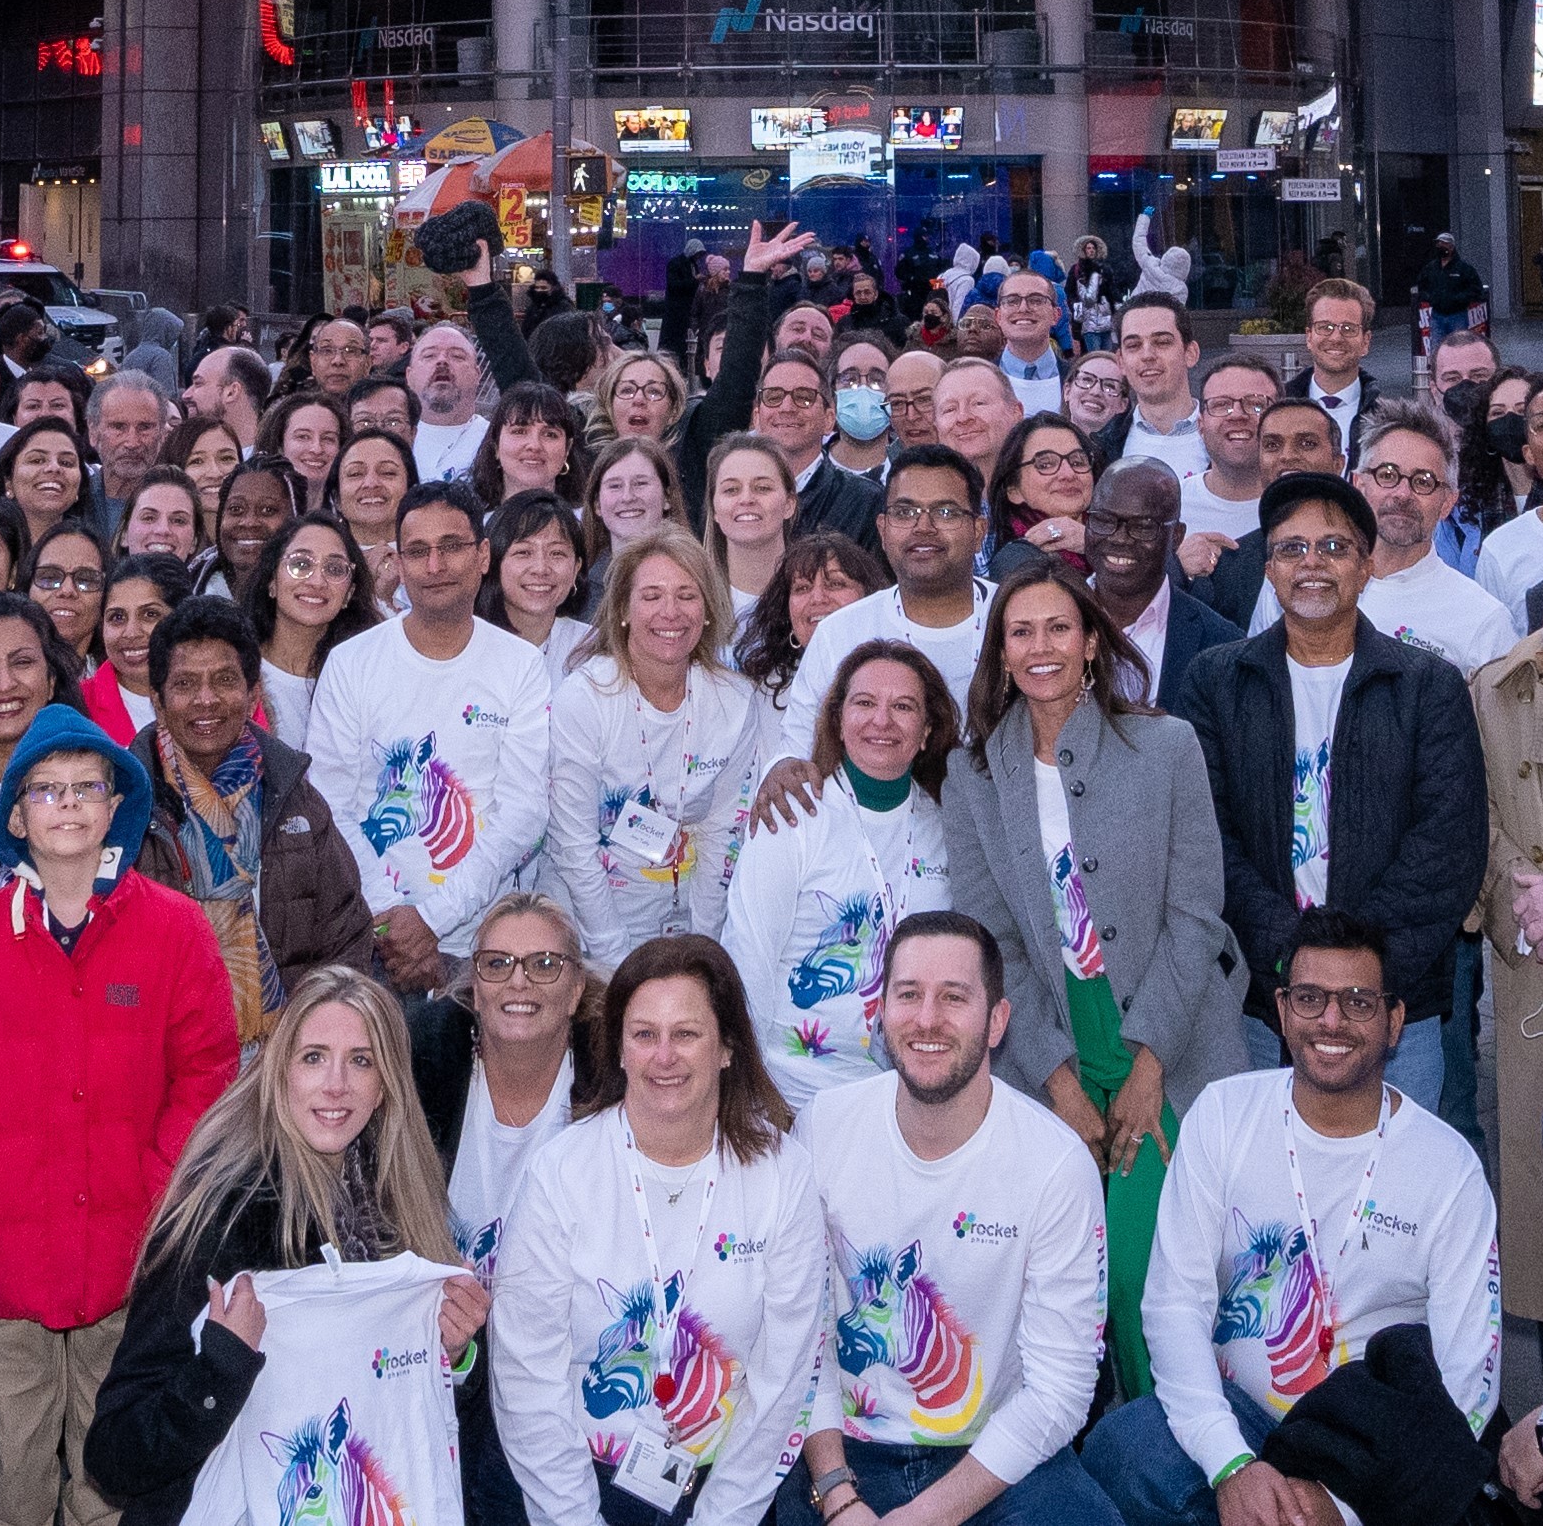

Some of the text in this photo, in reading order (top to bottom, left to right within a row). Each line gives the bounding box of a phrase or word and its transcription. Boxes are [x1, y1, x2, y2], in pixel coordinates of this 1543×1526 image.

[765, 7, 876, 38] Nasdaq
[378, 23, 435, 50] Nasdaq
[476, 711, 509, 728] rocket
[970, 1221, 1019, 1239] rocket
[1368, 1210, 1419, 1237] rocket
[386, 1348, 428, 1371] rocket
